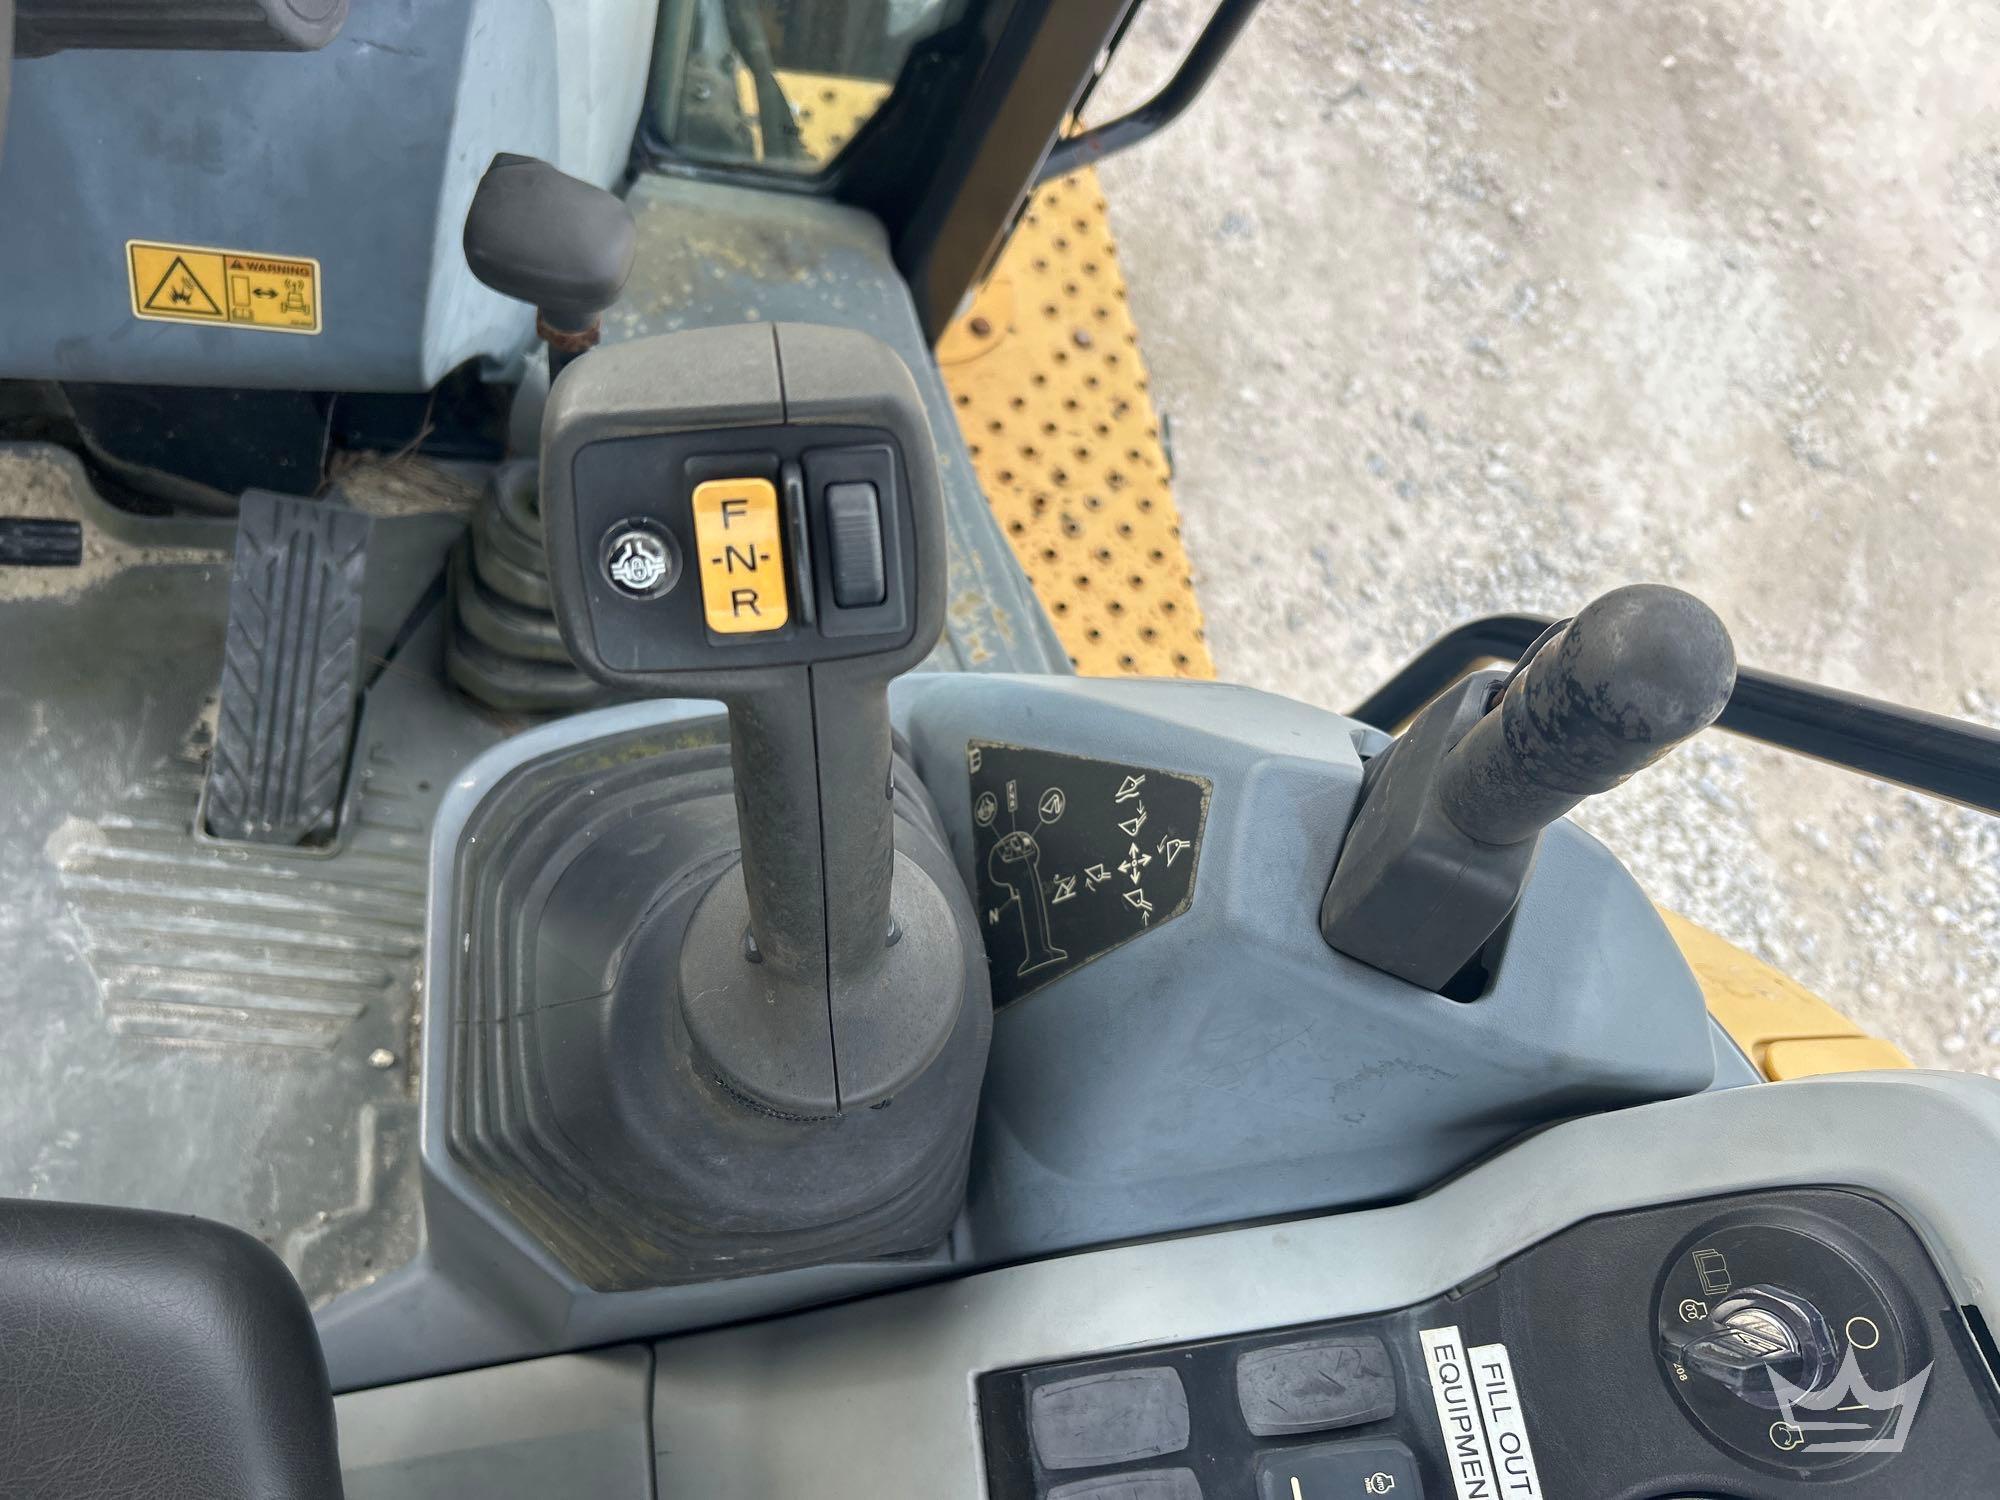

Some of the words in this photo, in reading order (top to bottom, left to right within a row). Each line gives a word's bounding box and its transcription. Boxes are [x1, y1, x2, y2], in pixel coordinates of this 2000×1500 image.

[245, 262, 310, 277] WARNING
[720, 499, 748, 529] F
[731, 589, 762, 618] R
[1481, 1362, 1512, 1423] FILL
[1500, 1431, 1533, 1495] OUT
